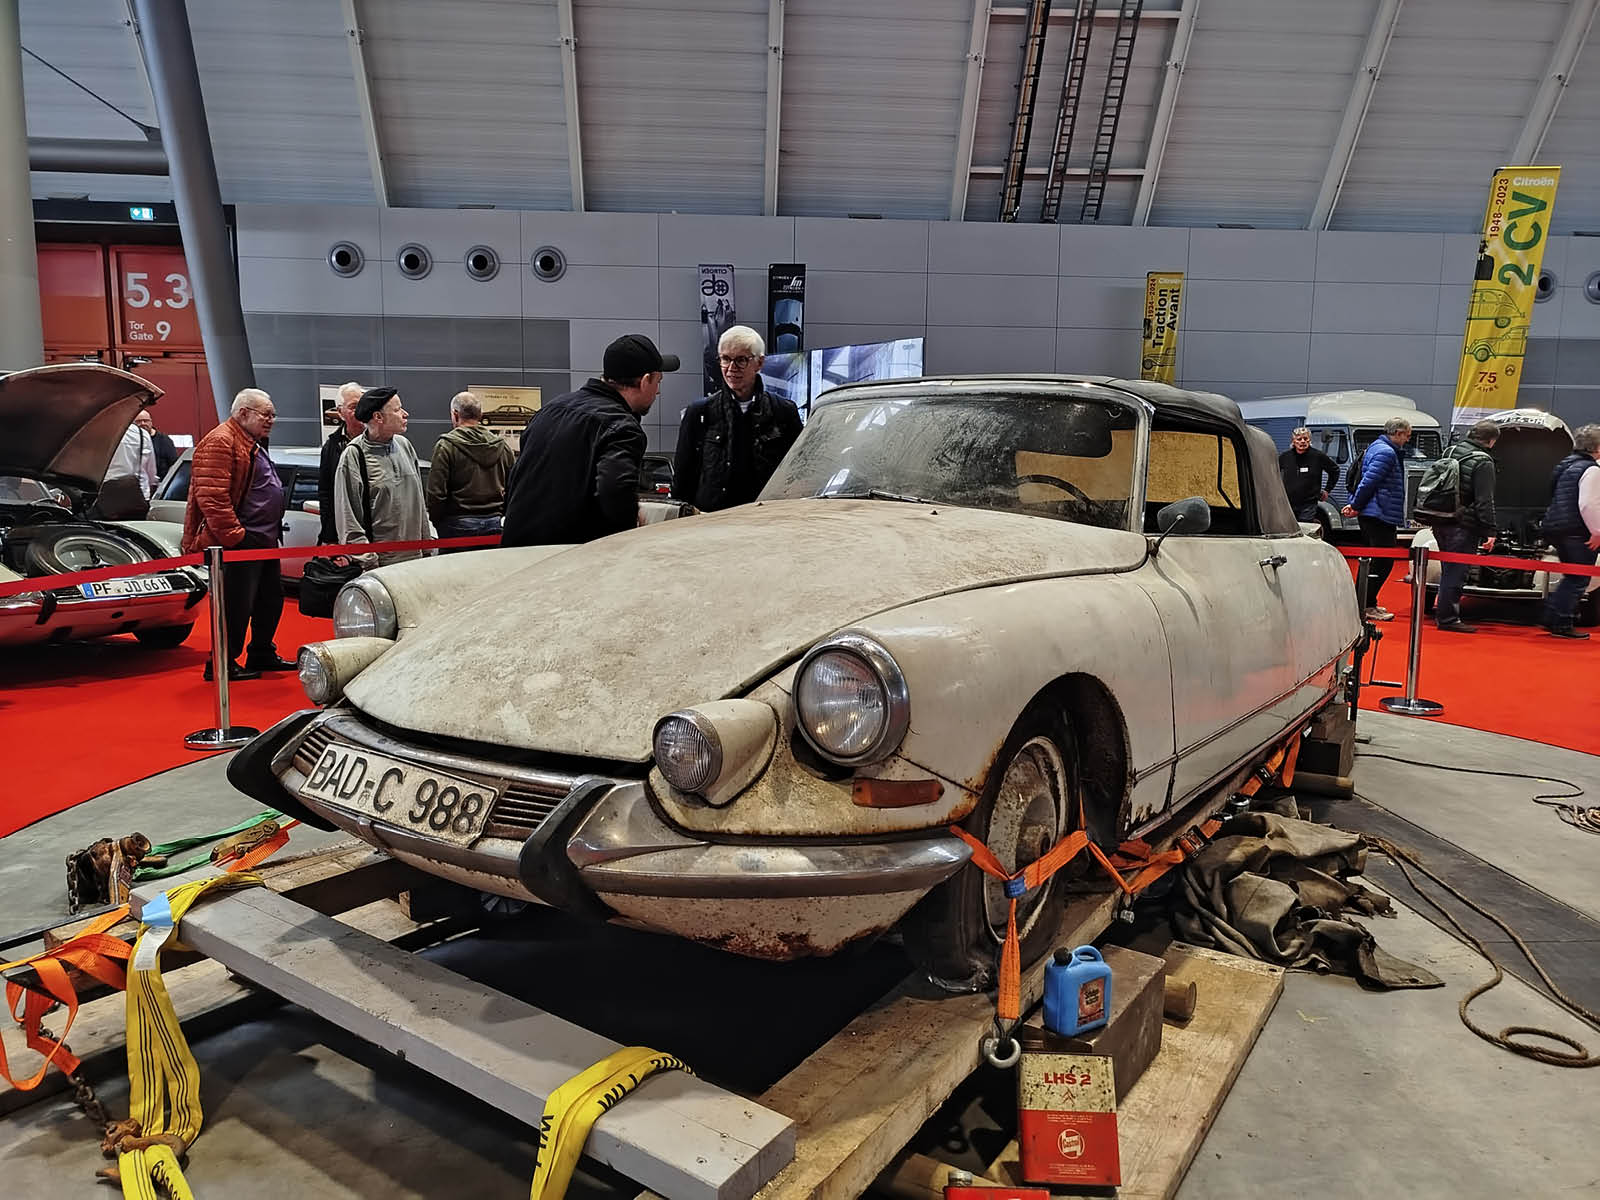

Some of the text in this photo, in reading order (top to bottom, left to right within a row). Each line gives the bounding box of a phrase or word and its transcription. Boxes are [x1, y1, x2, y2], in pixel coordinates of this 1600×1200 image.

[1513, 176, 1554, 186] Citroën
[126, 272, 189, 309] 5.3
[1166, 288, 1181, 331] Avant
[128, 320, 144, 330] Tor
[1152, 288, 1168, 348] Traction
[130, 331, 154, 341] Gate
[156, 320, 171, 341] 9
[1479, 371, 1497, 384] 75
[92, 583, 111, 595] PF
[408, 778, 483, 834] 988
[1044, 1071, 1091, 1085] LHS 2
